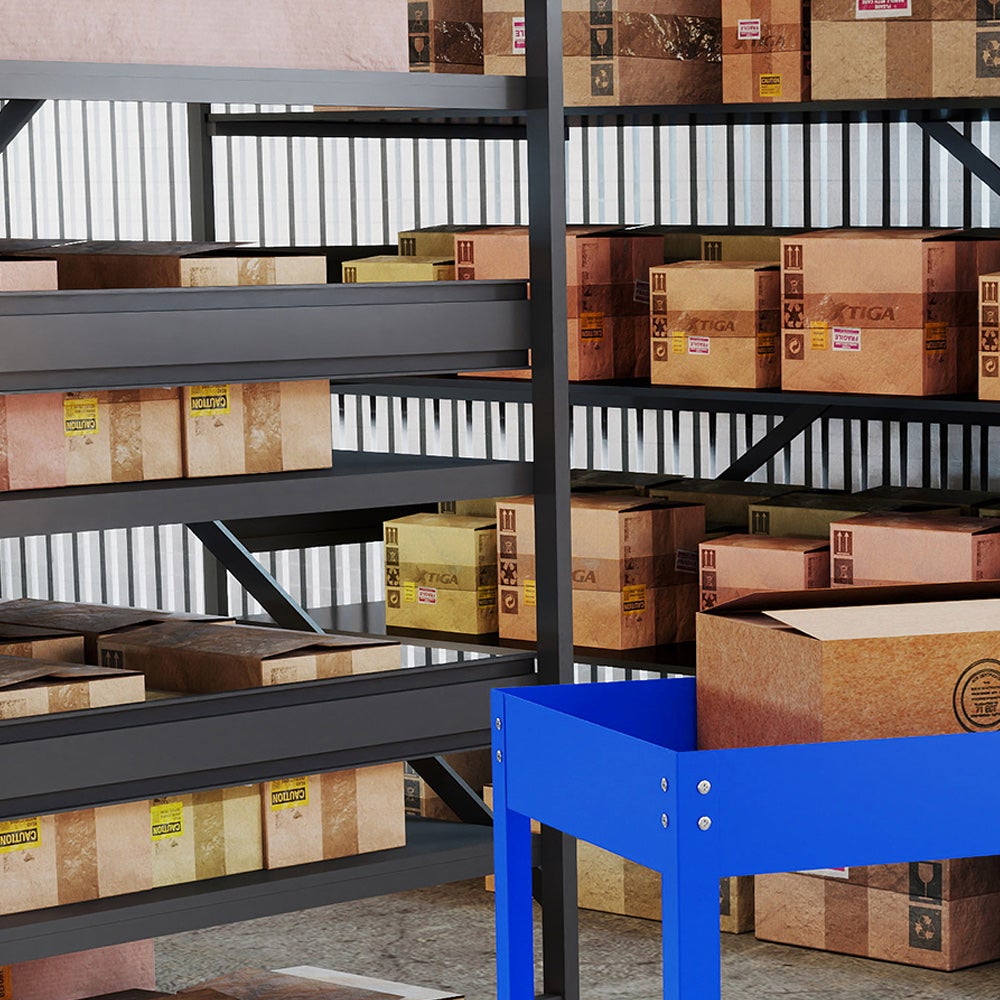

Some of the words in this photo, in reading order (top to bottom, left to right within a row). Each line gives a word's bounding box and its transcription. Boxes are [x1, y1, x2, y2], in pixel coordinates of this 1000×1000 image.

[192, 396, 227, 410] CAUTION
[66, 420, 96, 431] CAUTION
[272, 788, 306, 804] CAUTION
[153, 823, 181, 836] CAUTION
[0, 831, 37, 846] CAUTION
